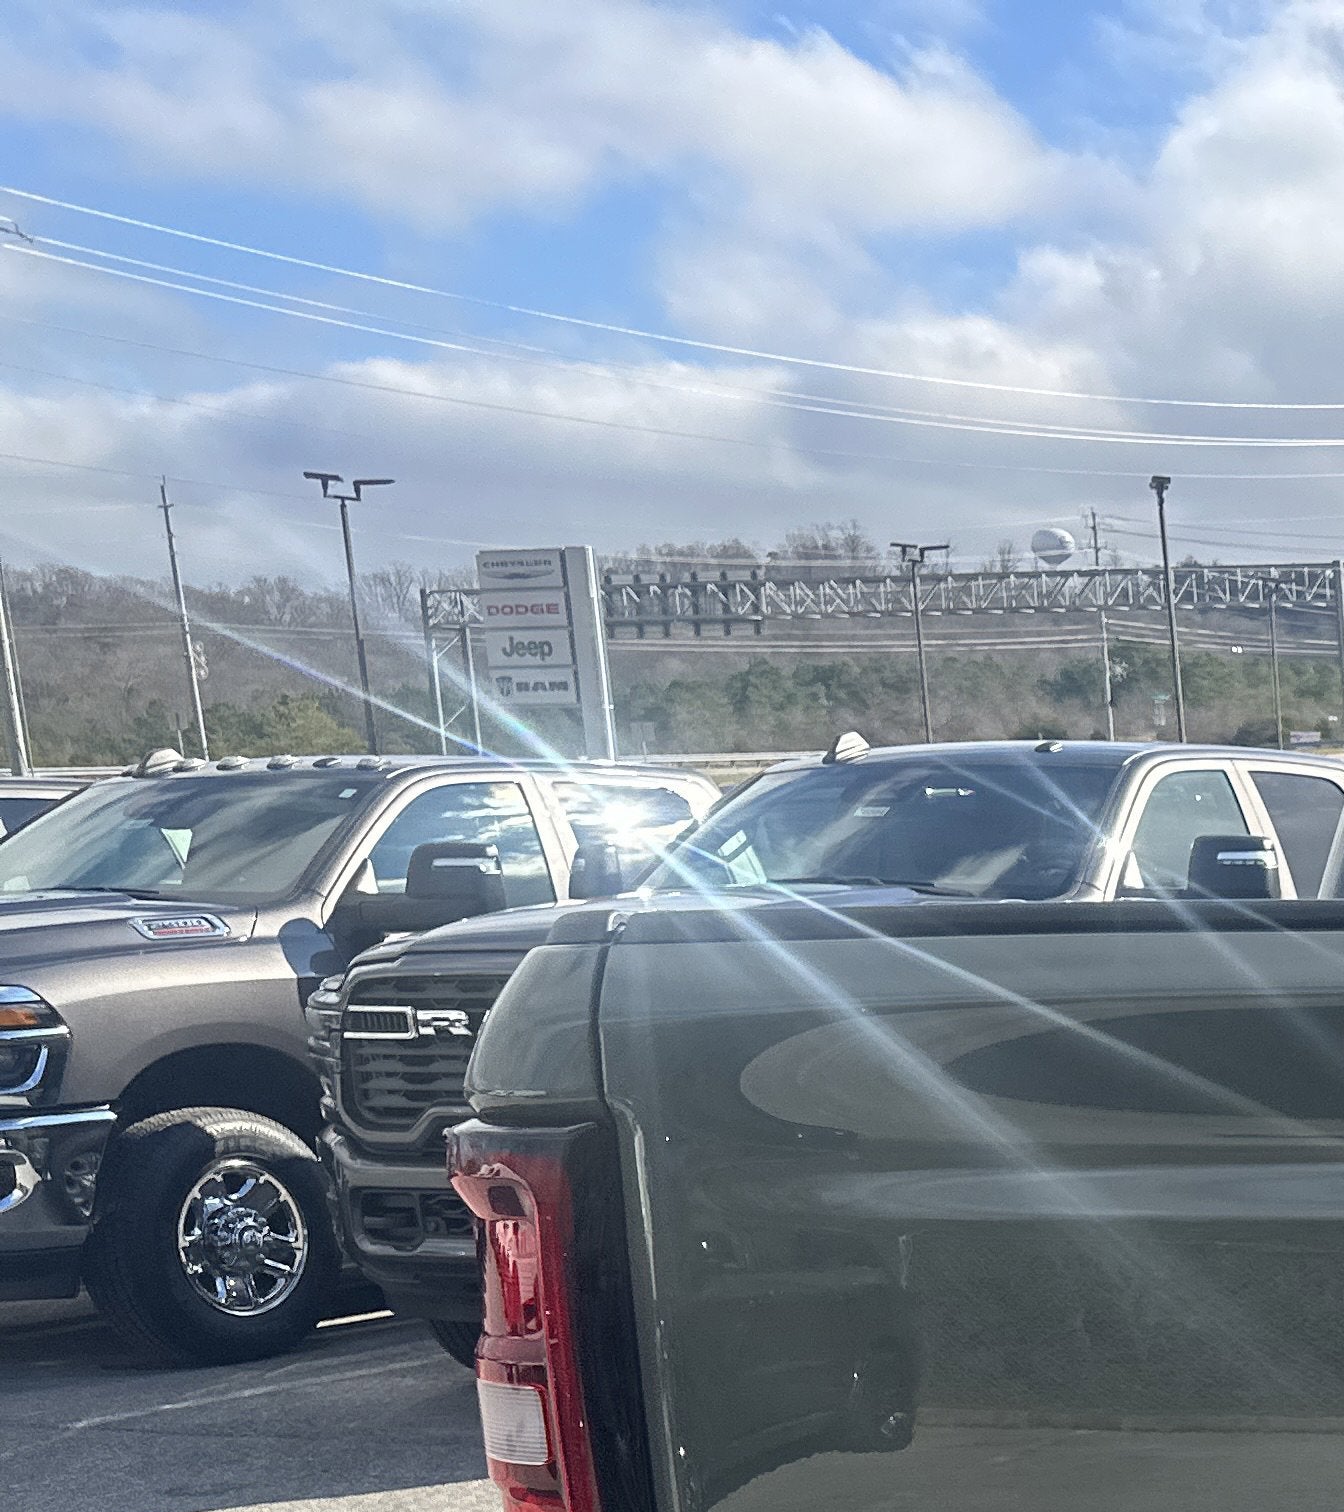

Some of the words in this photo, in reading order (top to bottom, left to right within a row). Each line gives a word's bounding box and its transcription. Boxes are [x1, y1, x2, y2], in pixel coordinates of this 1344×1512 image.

[486, 603, 560, 616] DODGE
[502, 636, 553, 661] Jeep
[515, 681, 569, 692] RAM
